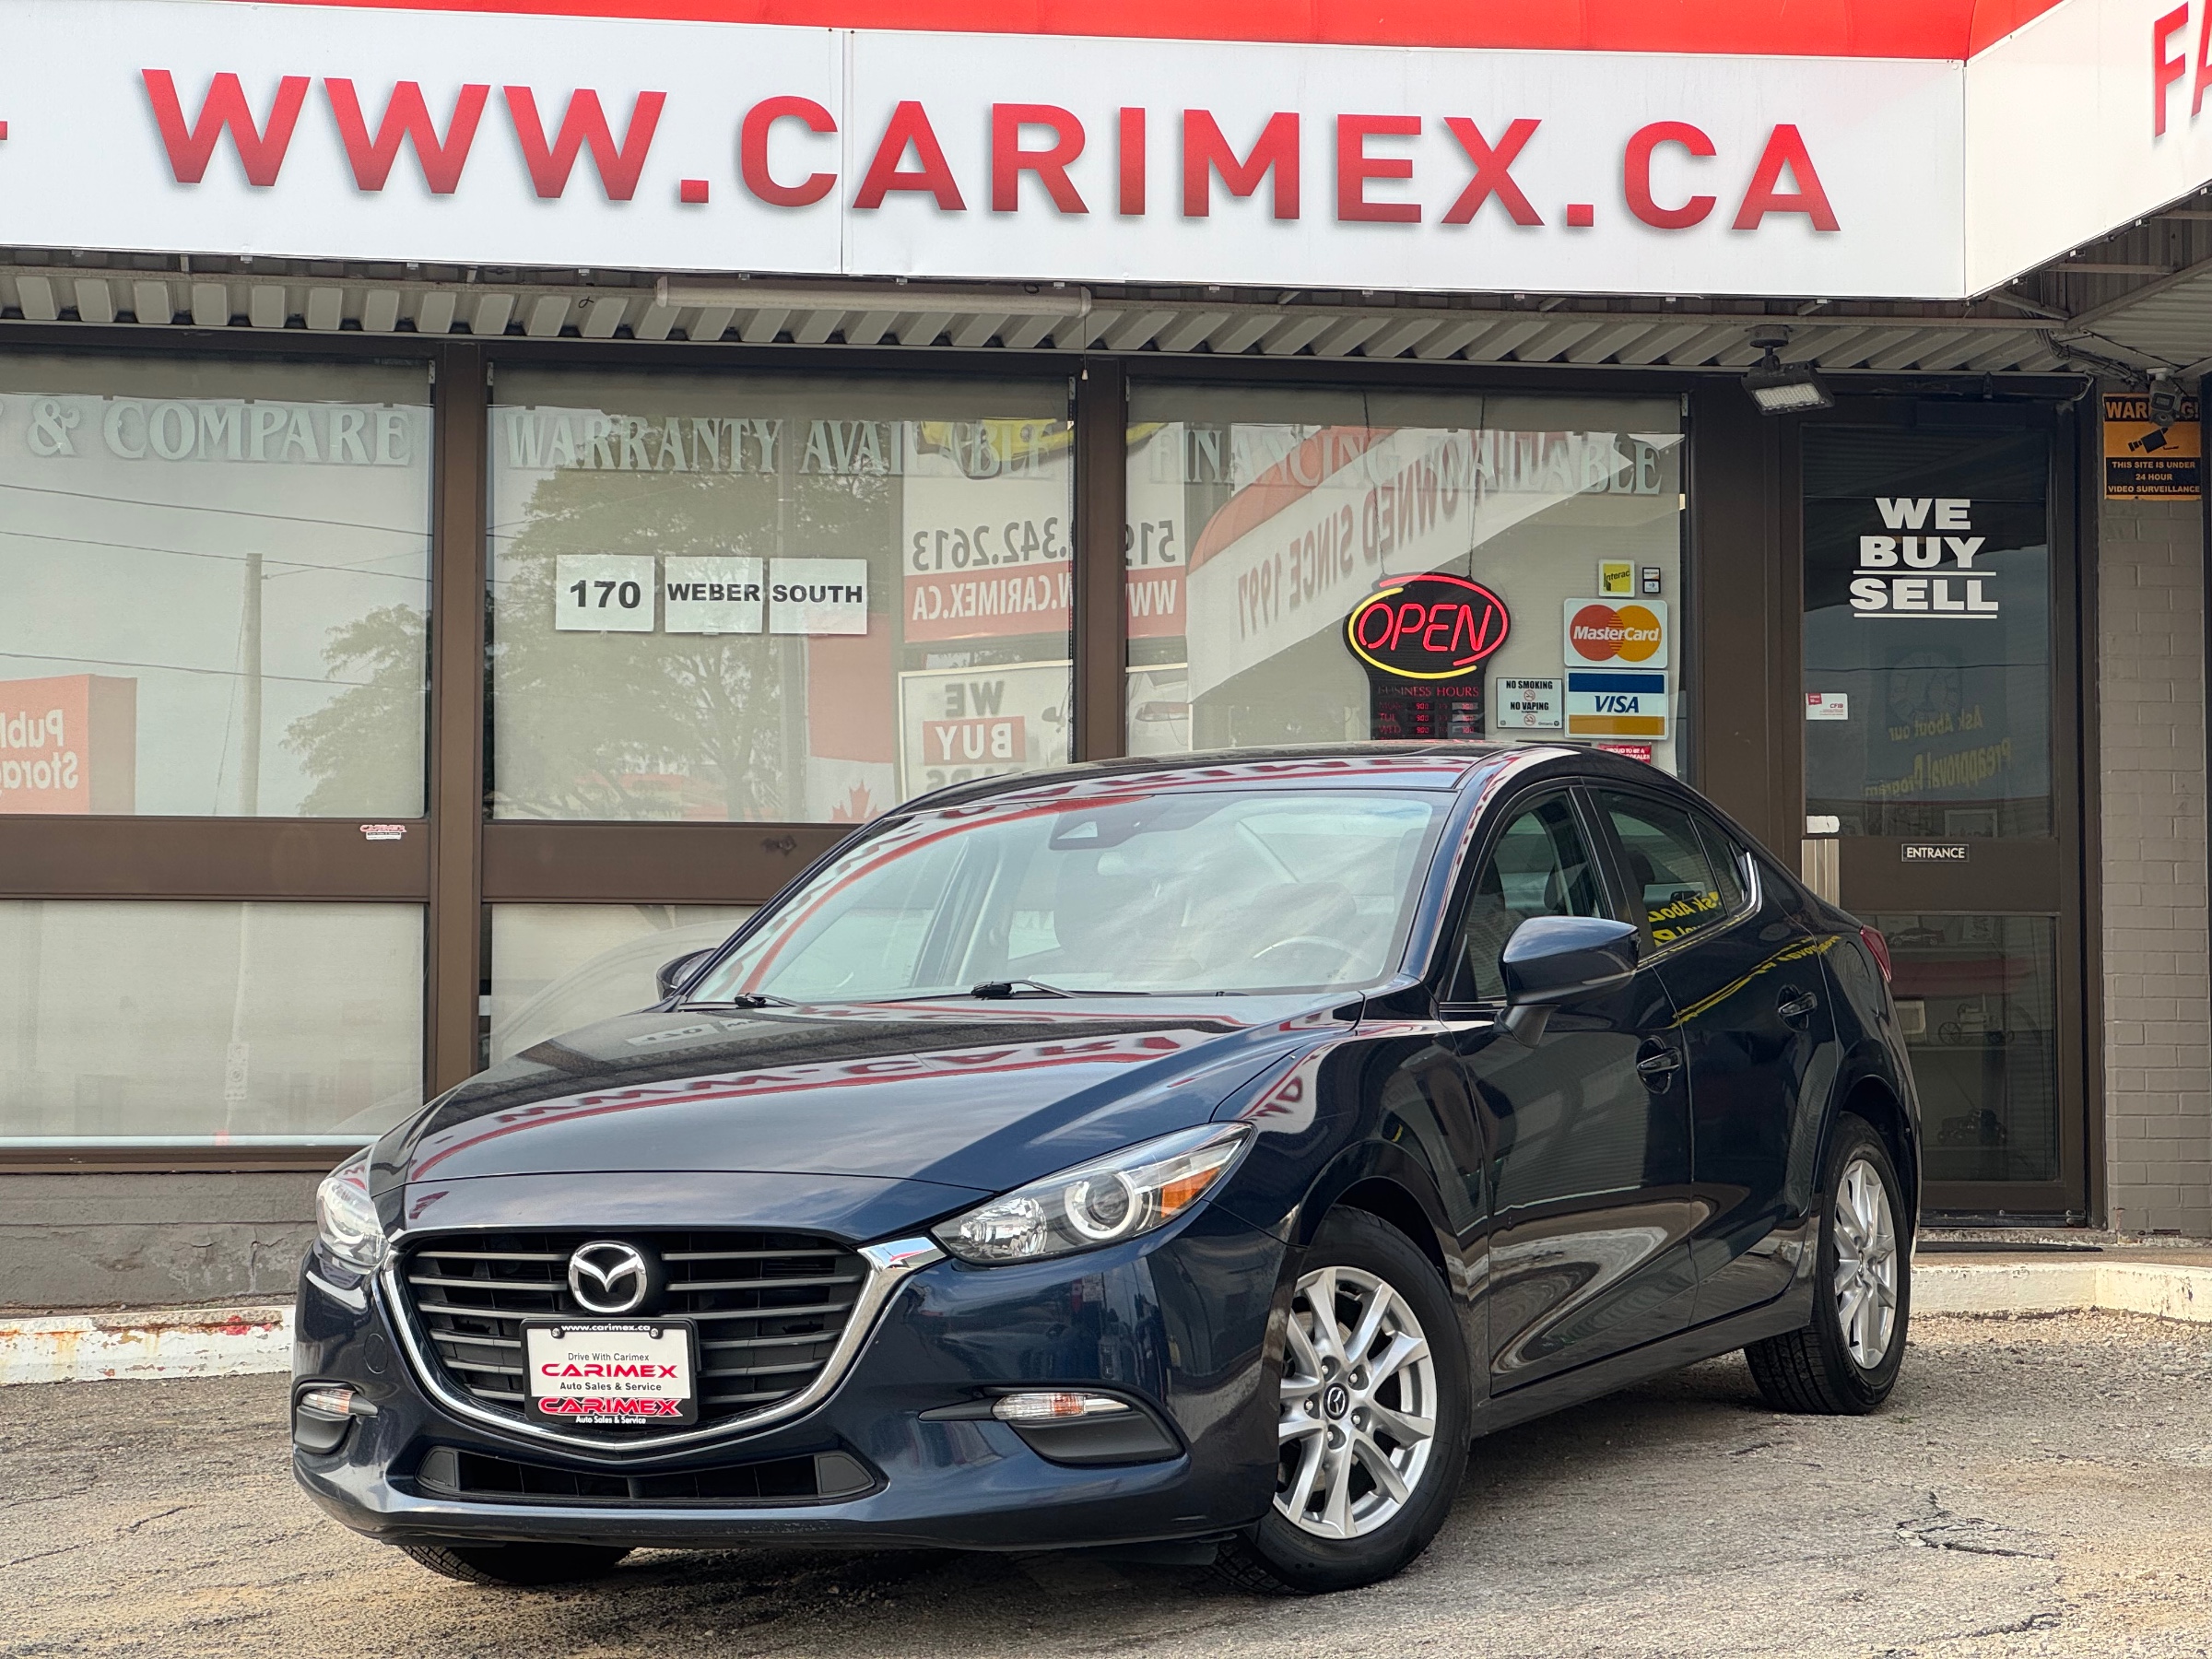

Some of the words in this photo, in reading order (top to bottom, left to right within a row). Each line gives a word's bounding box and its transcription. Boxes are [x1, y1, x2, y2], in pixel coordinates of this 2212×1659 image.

[141, 69, 1841, 231] WWW.CARIMEX.CA
[2105, 401, 2199, 419] WARG!
[27, 397, 81, 457] &
[103, 399, 412, 466] COMPARE
[507, 414, 782, 474] WARRANTY
[2136, 473, 2146, 481] 24
[2148, 473, 2172, 481] HOUR
[1875, 498, 1971, 530] WE
[1860, 535, 1985, 569] BUY
[1604, 571, 1630, 587] Interac
[570, 580, 641, 608] 170
[667, 583, 761, 601] WEBER
[772, 584, 863, 604] SOUTH
[1849, 578, 1998, 611] SELL
[1358, 603, 1492, 652] OPEN
[1573, 625, 1660, 642] MasterCard
[1436, 686, 1479, 697] HOURS
[1506, 680, 1517, 688] NO
[1518, 680, 1553, 689] SMOKING
[1510, 701, 1521, 711] NO
[1522, 701, 1549, 711] VAPING
[1594, 695, 1640, 713] VISA
[1907, 847, 1965, 858] ENTRANCE
[561, 1324, 651, 1332] www.carimex.ca
[568, 1353, 590, 1361] Drive
[592, 1353, 611, 1361] With
[613, 1353, 650, 1361] Carimex
[541, 1363, 678, 1378] CARIMEX
[559, 1382, 582, 1391] Auto
[585, 1382, 612, 1391] Sales
[625, 1382, 662, 1391] Service
[538, 1396, 683, 1417] CARIMEX
[575, 1416, 593, 1424] Auto
[594, 1416, 612, 1424] Sales
[621, 1416, 646, 1425] Service
